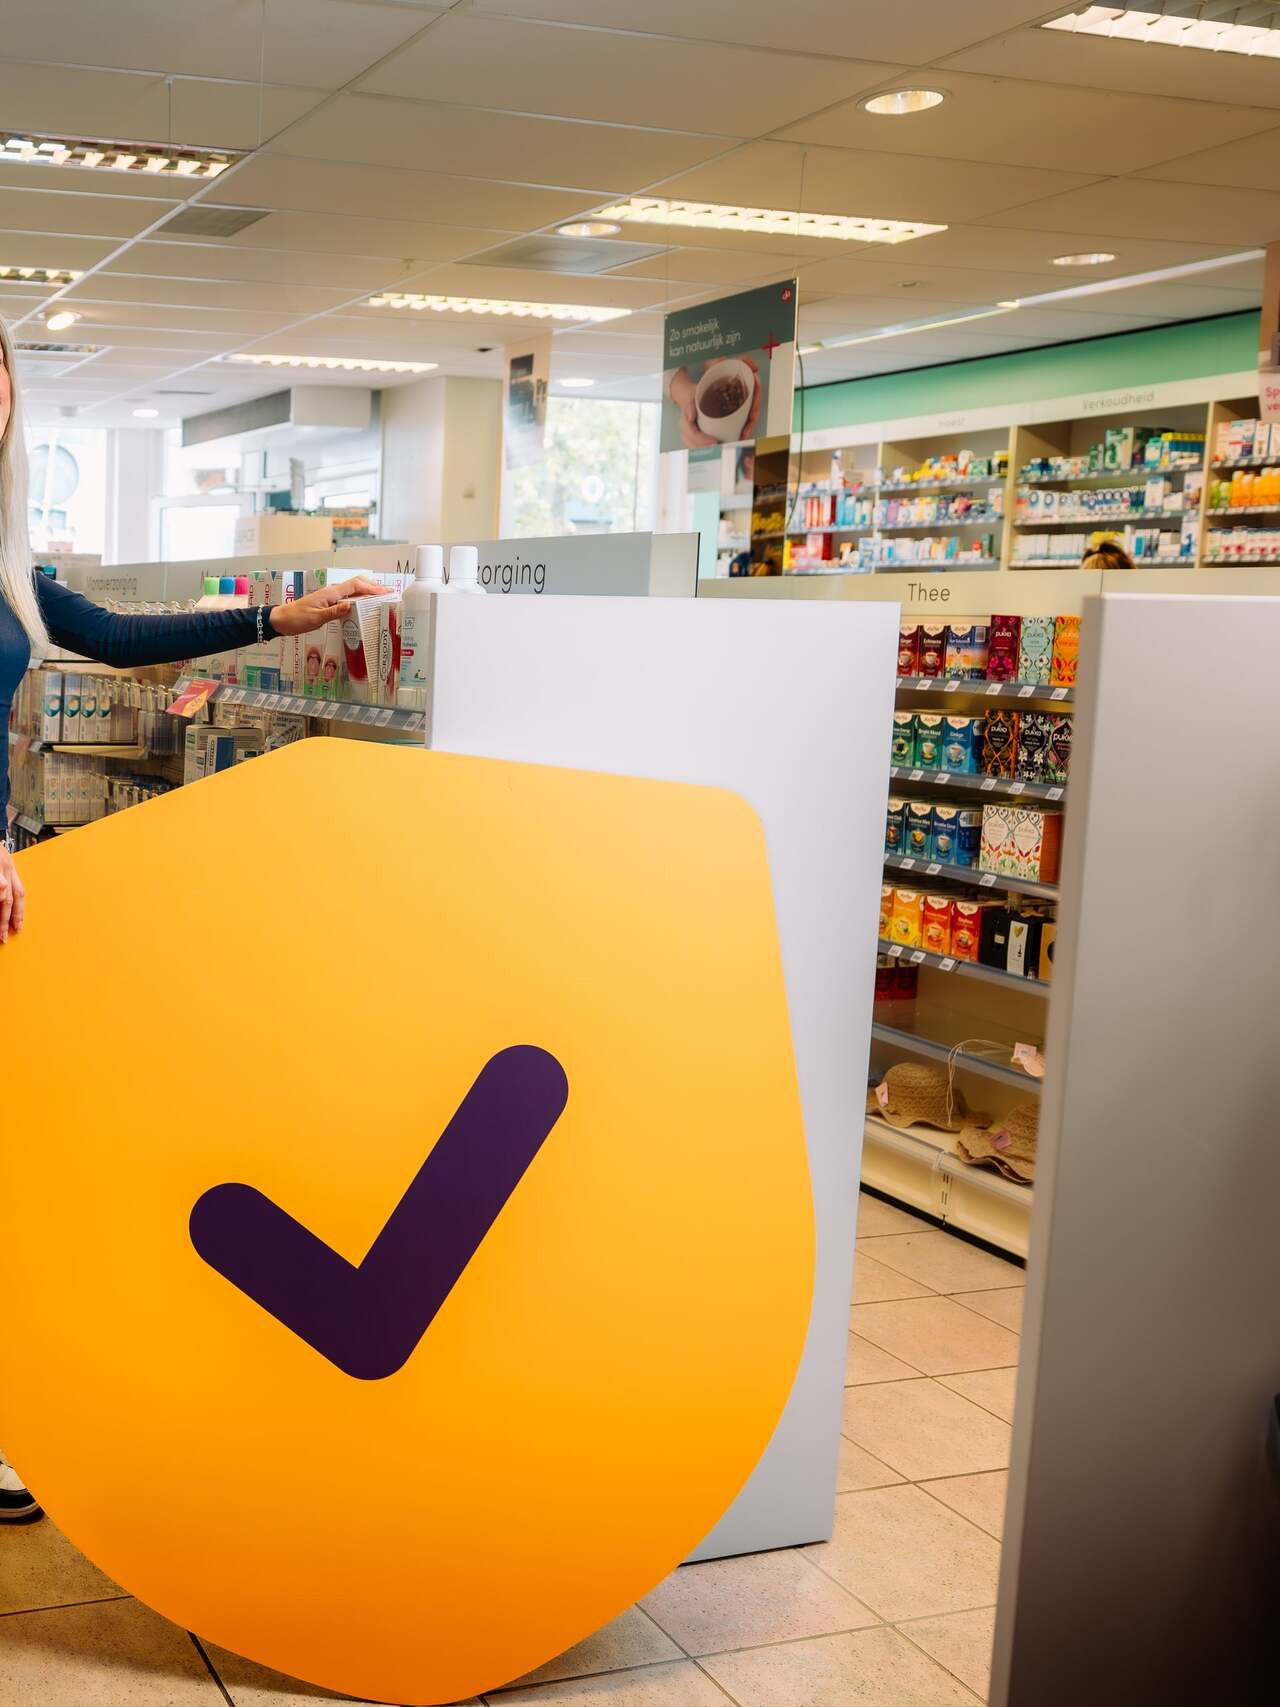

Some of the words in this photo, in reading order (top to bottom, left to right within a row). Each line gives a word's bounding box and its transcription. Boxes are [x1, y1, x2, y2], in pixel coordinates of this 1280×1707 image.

[669, 327, 681, 342] Zo
[682, 318, 720, 338] smakelijk
[669, 344, 685, 357] kan
[685, 334, 724, 353] natuurlijk
[725, 330, 741, 347] zijn
[1082, 390, 1155, 411] Verkoudheid
[396, 556, 546, 594] Mvorging
[908, 583, 951, 602] Thee
[995, 631, 1012, 639] pukka
[990, 725, 1008, 734] pukka
[1024, 729, 1042, 738] pukka
